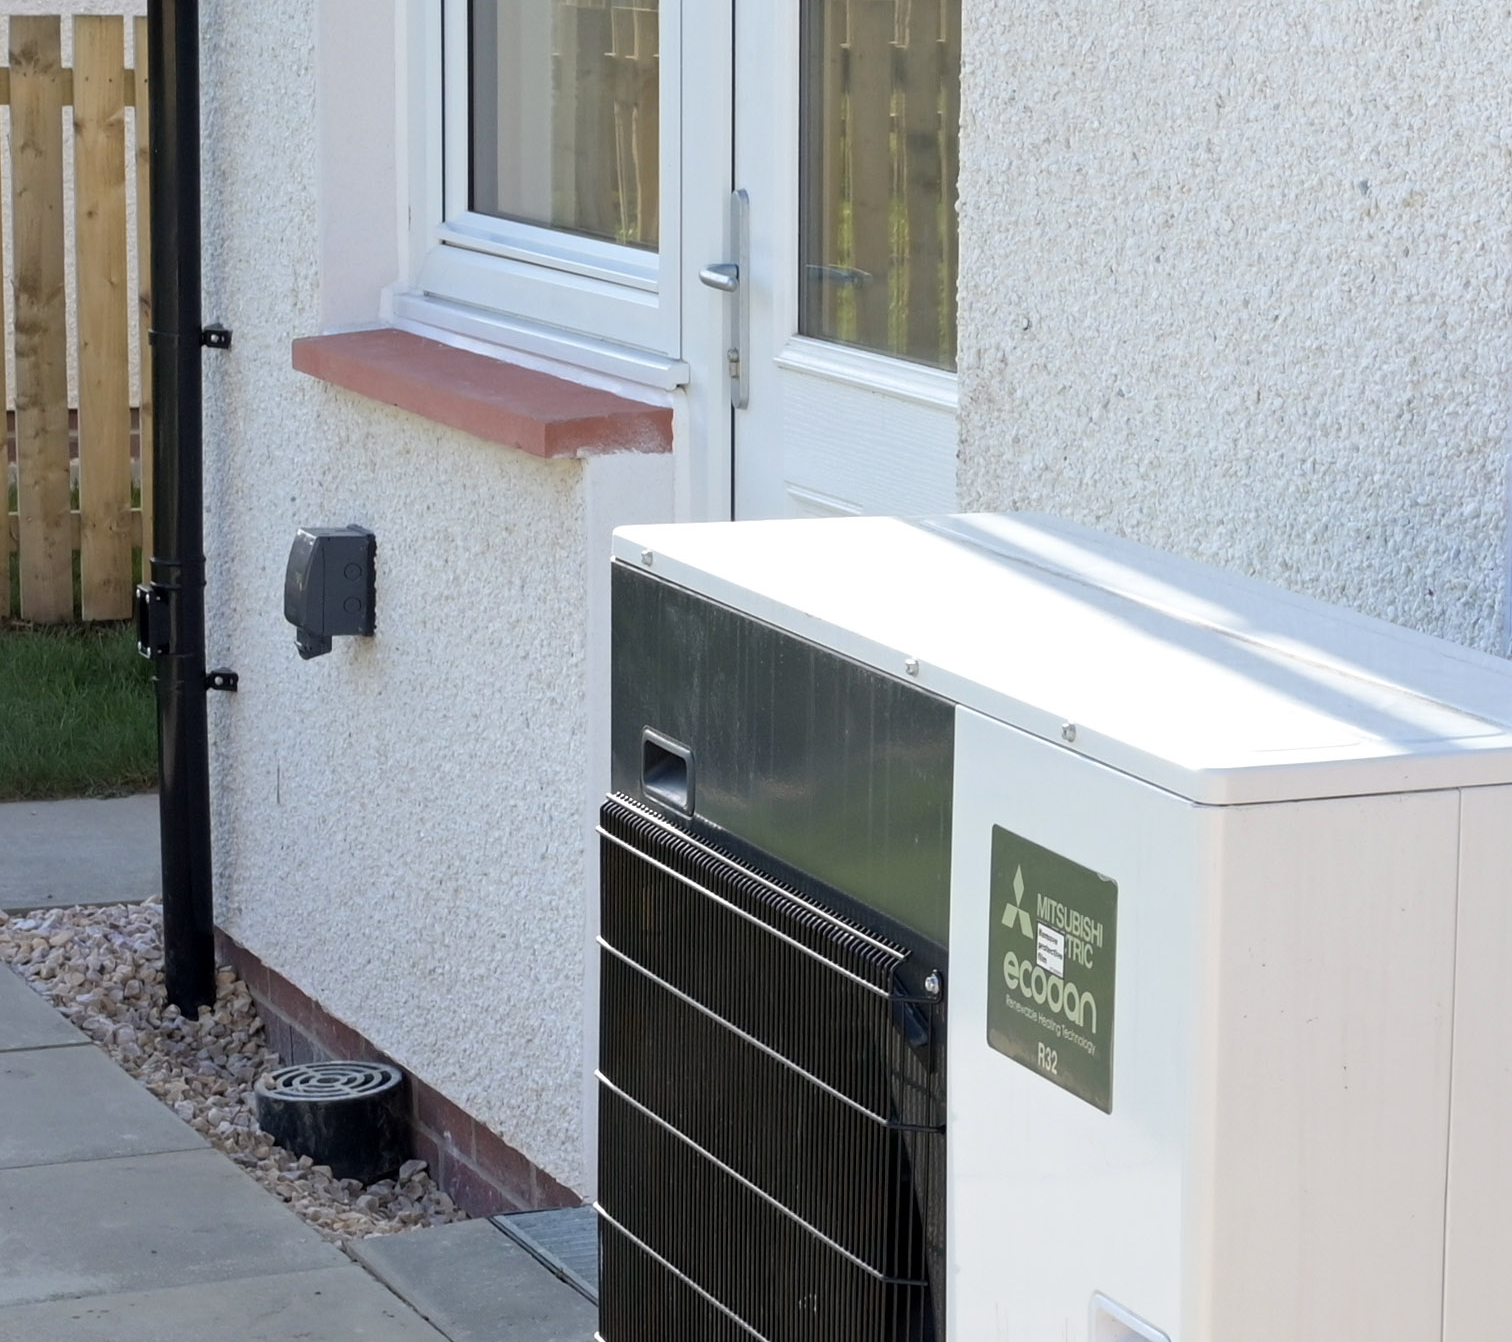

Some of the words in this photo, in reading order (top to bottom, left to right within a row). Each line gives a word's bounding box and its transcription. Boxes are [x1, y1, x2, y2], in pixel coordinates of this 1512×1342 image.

[1036, 893, 1103, 948] MITSUBISHI
[1038, 1012, 1061, 1037] Heating
[1062, 1024, 1095, 1056] Technology
[1038, 1042, 1058, 1075] R32
